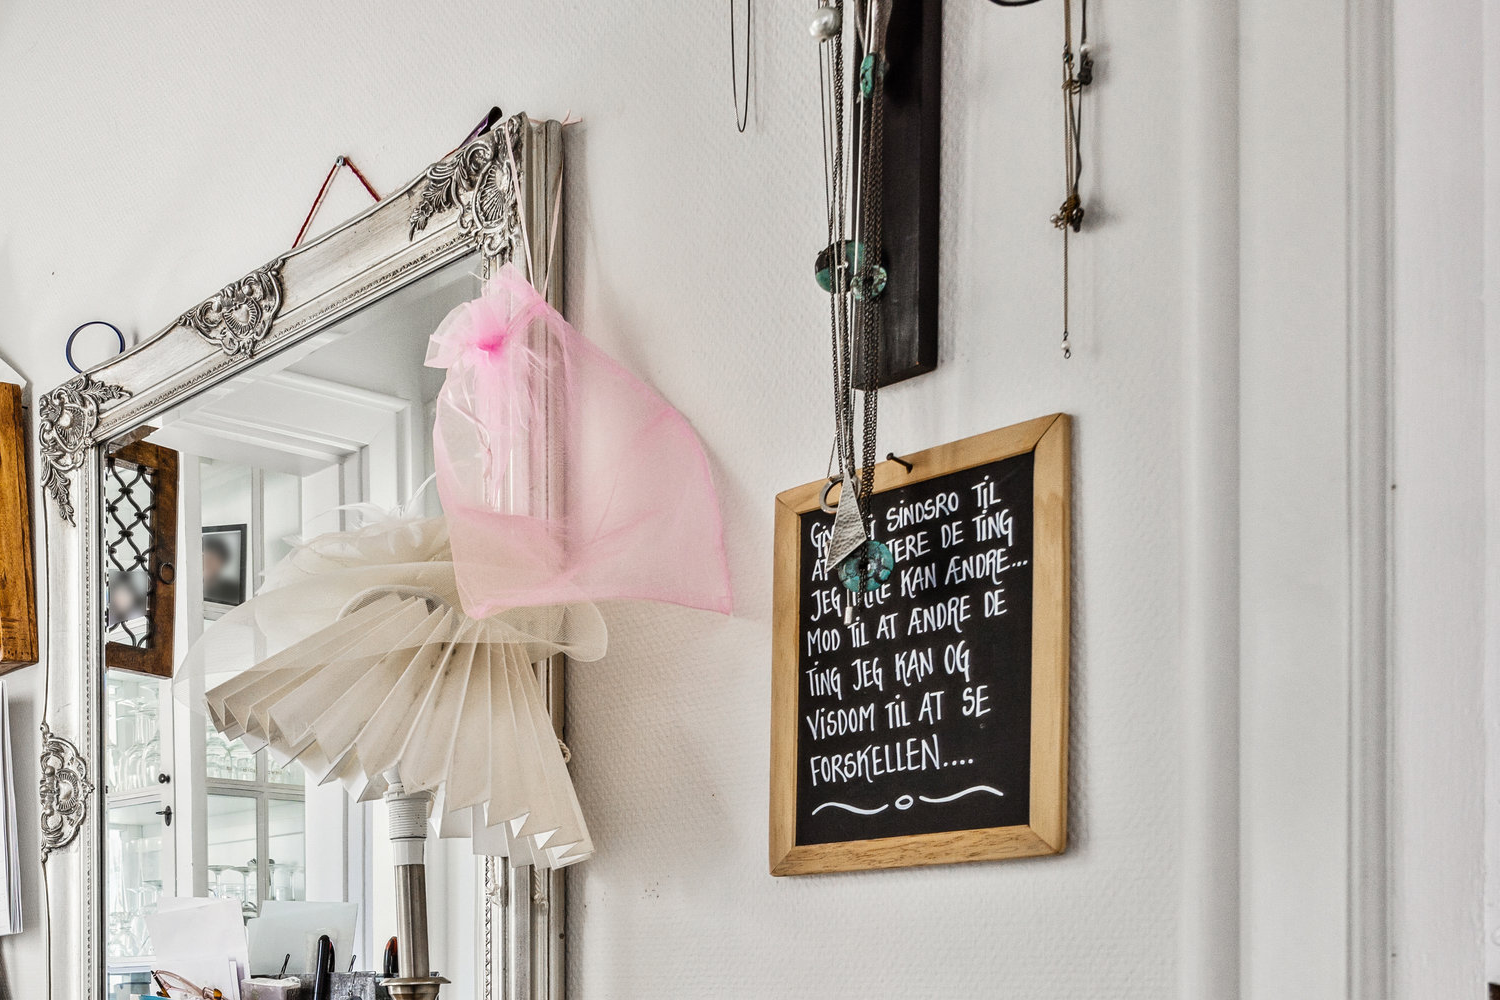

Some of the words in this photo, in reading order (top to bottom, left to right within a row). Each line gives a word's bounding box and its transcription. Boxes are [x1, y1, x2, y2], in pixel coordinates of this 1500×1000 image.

[886, 491, 959, 532] SINDSRO
[971, 475, 1002, 509] TIL
[941, 521, 964, 549] DE
[972, 508, 1014, 547] TING
[811, 586, 842, 621] JEG
[901, 563, 937, 599] KAN
[807, 627, 841, 657] MOD
[847, 616, 870, 648] TIL
[876, 612, 899, 640] AT
[907, 595, 972, 635] ÆNDRE
[984, 588, 1008, 618] DE
[805, 661, 843, 701] TING
[851, 657, 884, 692] JEG
[895, 647, 934, 687] KAN
[944, 640, 970, 683] OG
[806, 703, 875, 741] VISDOM
[884, 694, 911, 729] TIL
[918, 690, 945, 725] AT
[962, 685, 991, 718] SE
